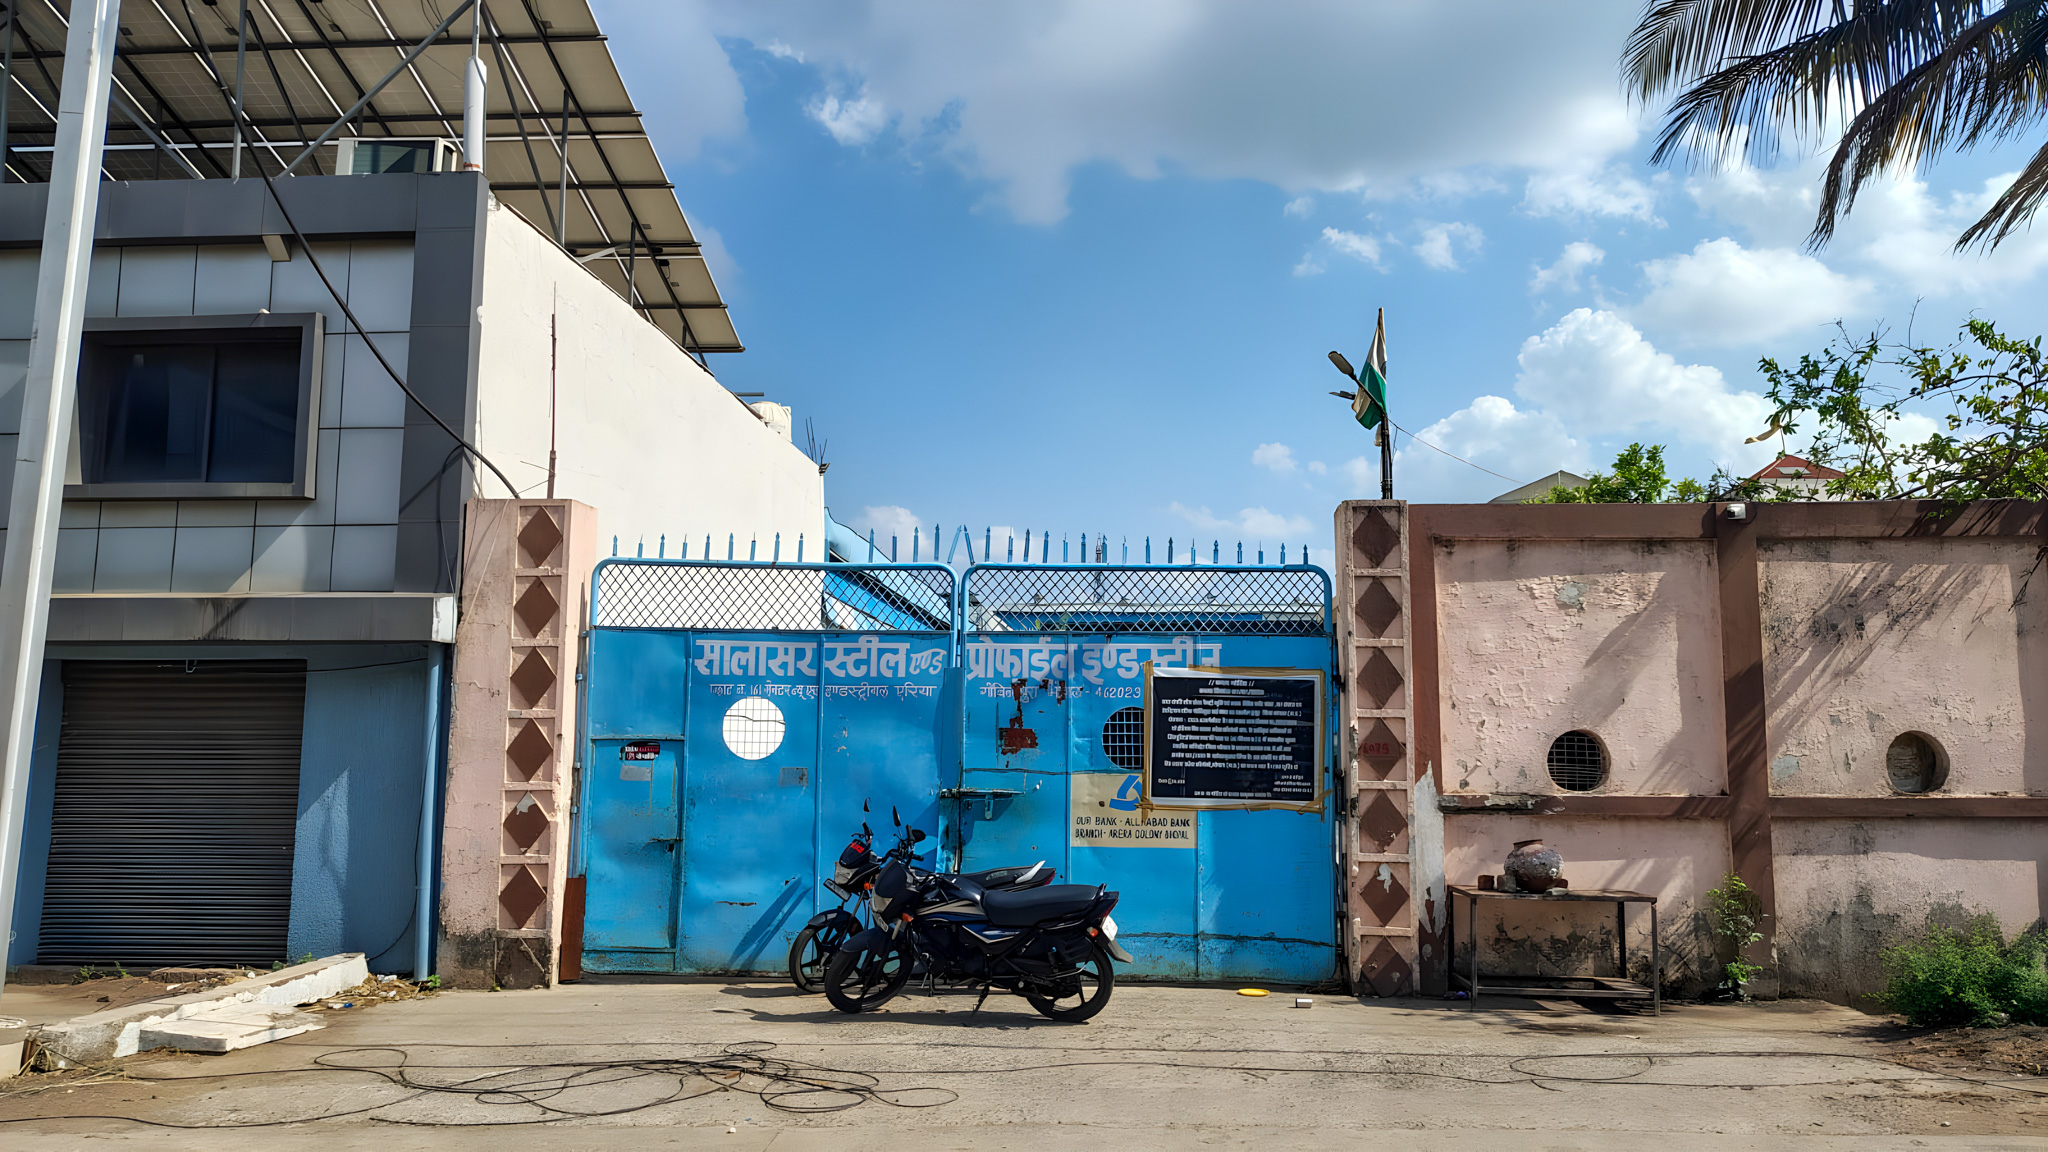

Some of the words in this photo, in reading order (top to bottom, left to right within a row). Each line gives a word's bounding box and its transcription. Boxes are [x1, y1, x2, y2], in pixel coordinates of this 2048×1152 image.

[694, 639, 818, 677] सालासर
[823, 635, 911, 678] स्टील
[750, 684, 762, 696] 161
[1095, 816, 1117, 826] BANK
[1170, 818, 1191, 828] BANK
